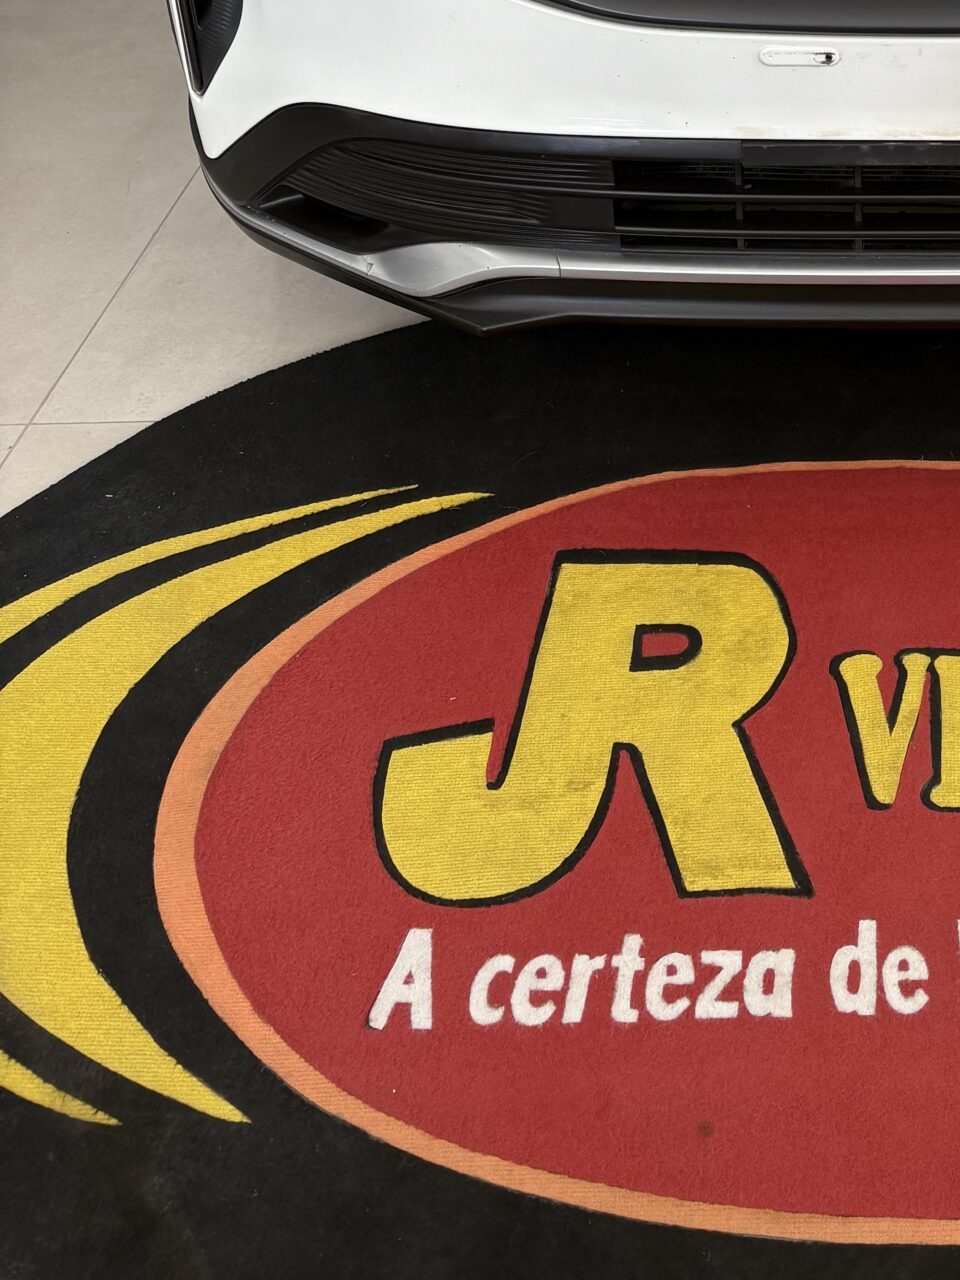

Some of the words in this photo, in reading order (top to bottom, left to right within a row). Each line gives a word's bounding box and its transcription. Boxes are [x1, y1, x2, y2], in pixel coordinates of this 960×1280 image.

[373, 548, 814, 907] JR
[368, 928, 432, 1029] A
[469, 933, 795, 1026] certeza
[829, 919, 929, 1016] de
